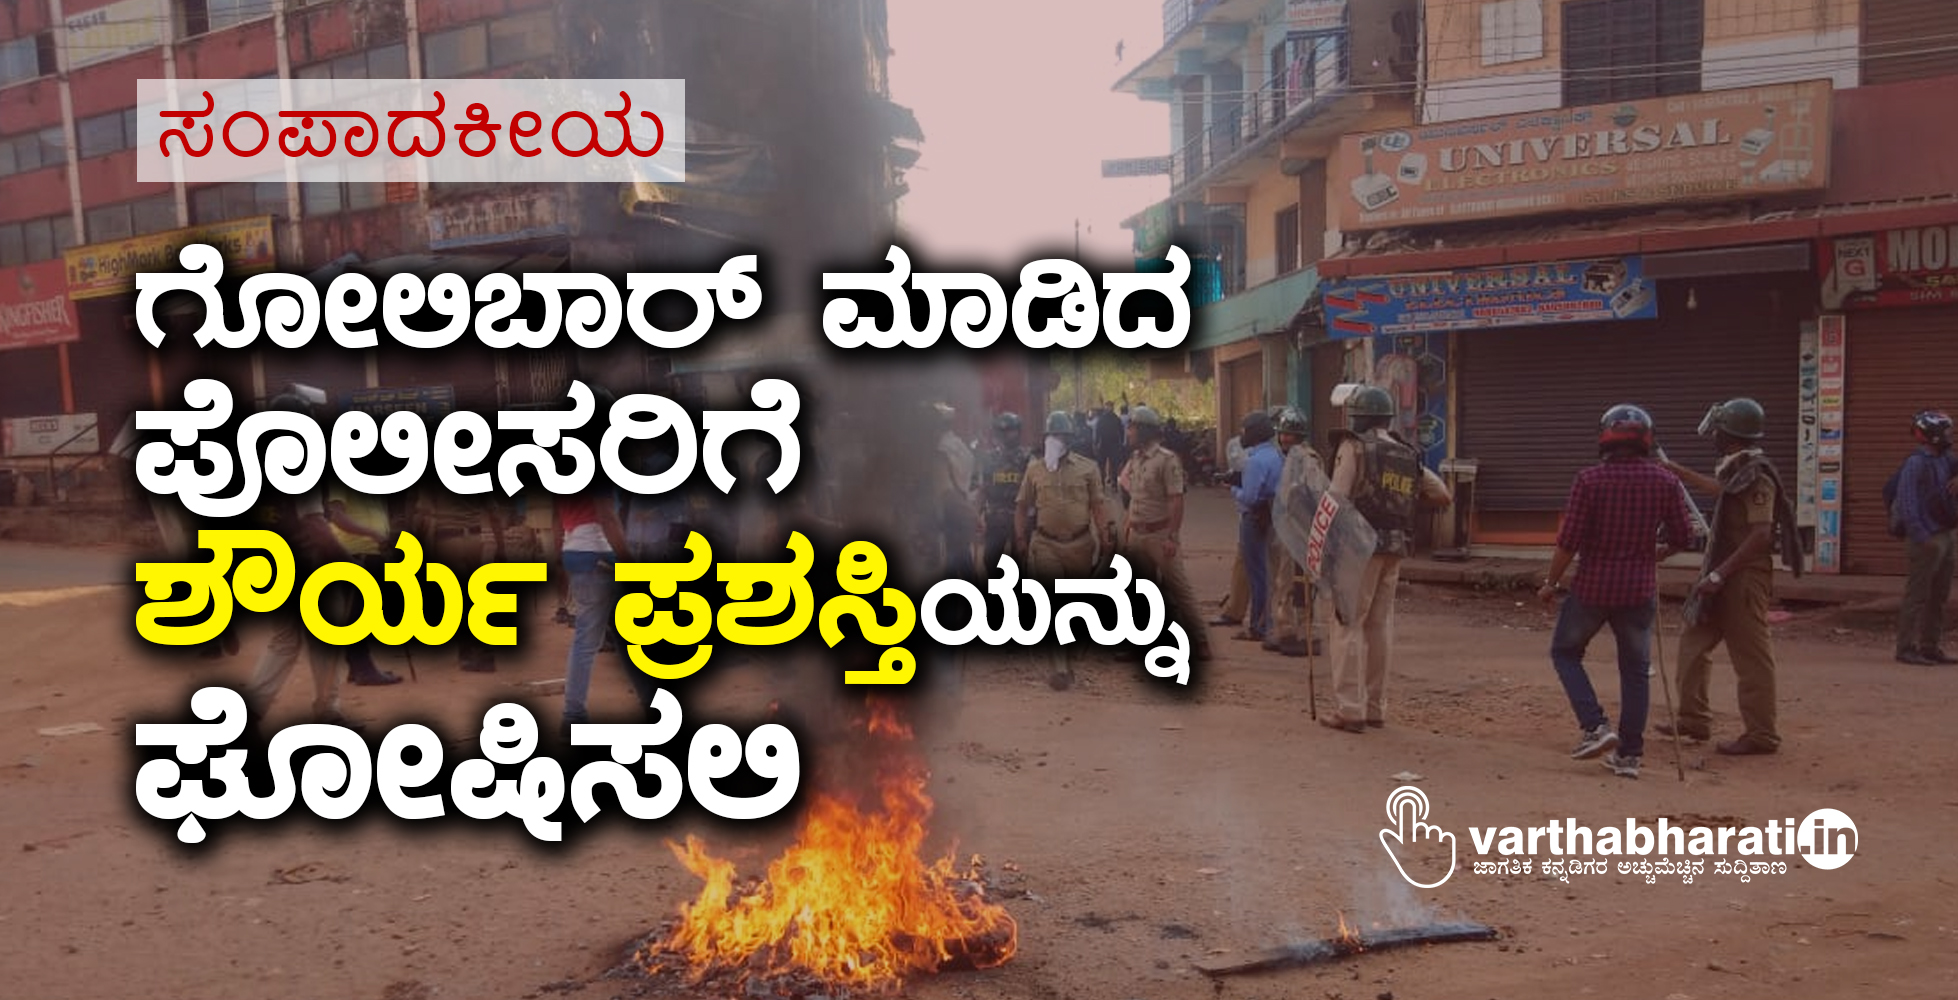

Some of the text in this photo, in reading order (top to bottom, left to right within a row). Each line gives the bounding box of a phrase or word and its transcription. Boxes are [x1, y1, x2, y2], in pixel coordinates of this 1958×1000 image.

[1439, 118, 1733, 173] UNIVERSAL
[1424, 160, 1618, 191] ELECTRONICS
[1388, 263, 1578, 297] UNIVERSAL
[1844, 259, 1867, 278] G
[1306, 495, 1337, 573] POLICE
